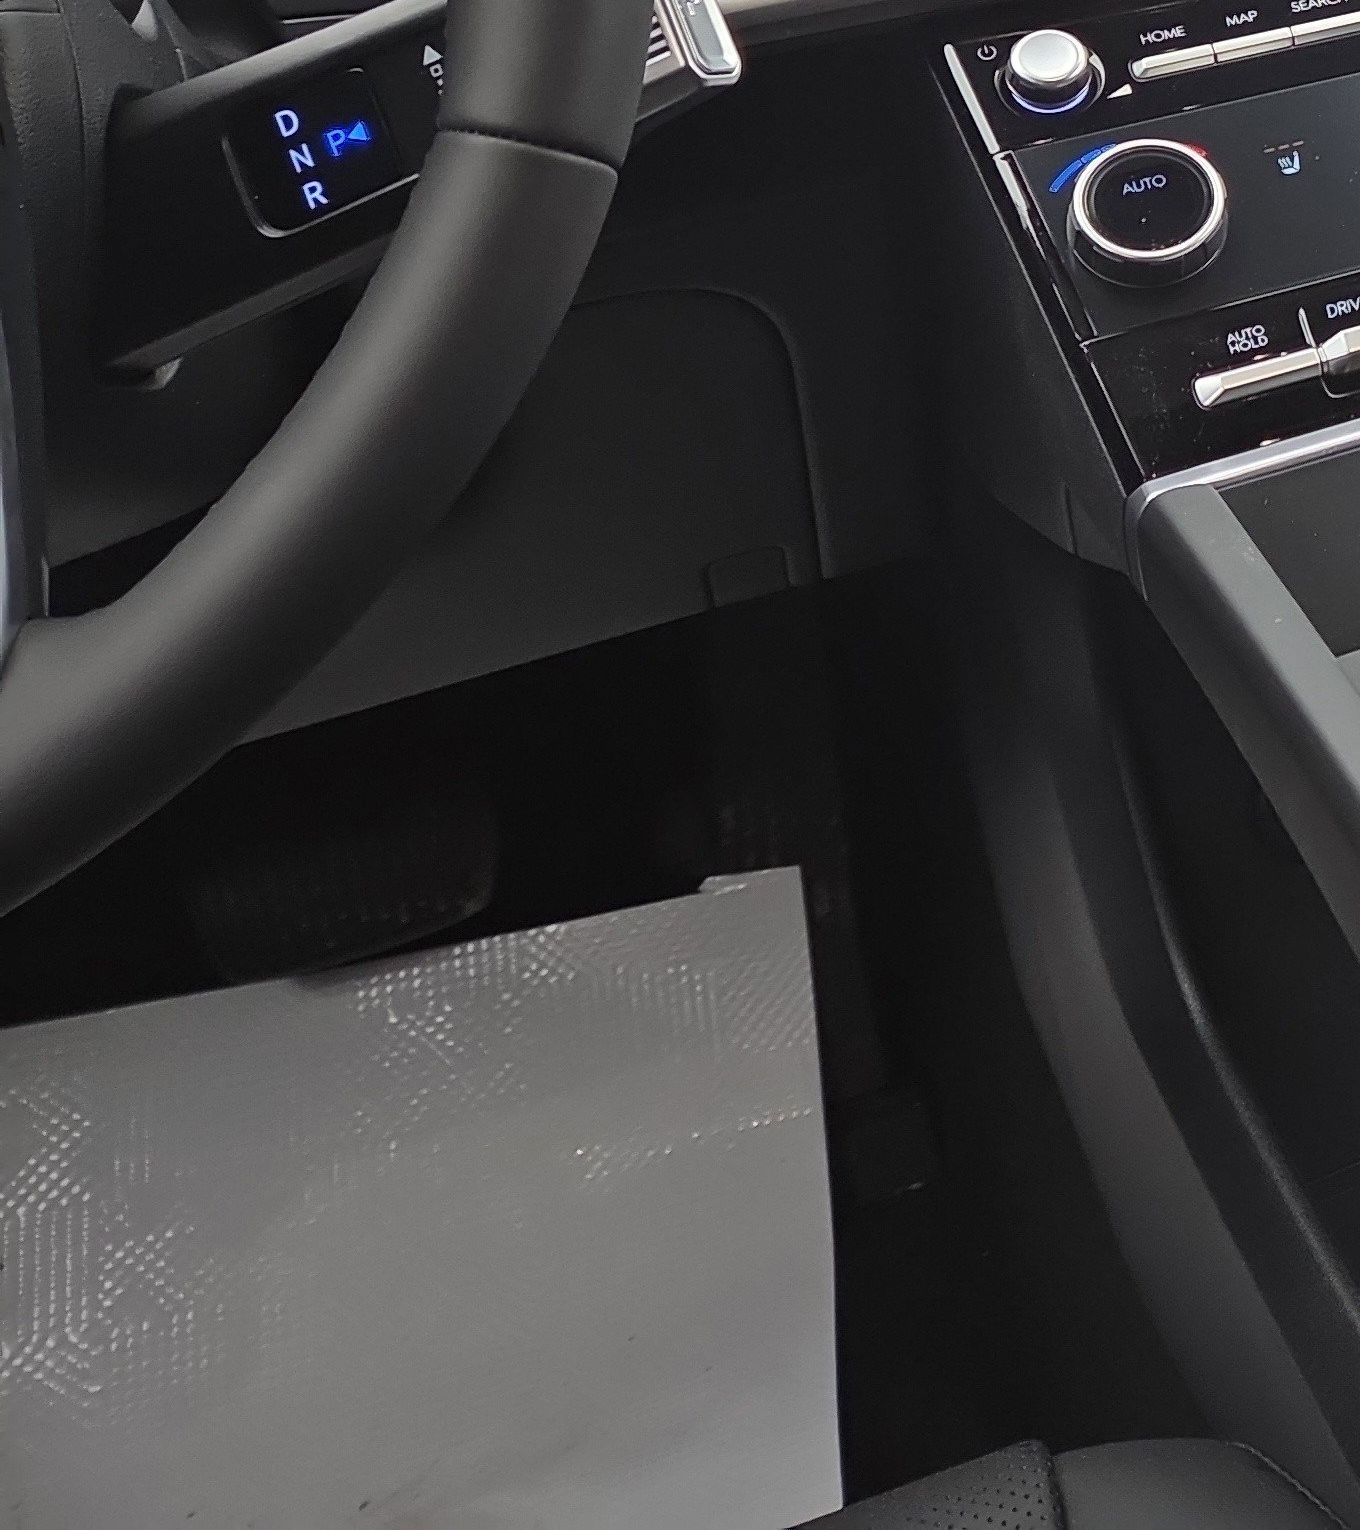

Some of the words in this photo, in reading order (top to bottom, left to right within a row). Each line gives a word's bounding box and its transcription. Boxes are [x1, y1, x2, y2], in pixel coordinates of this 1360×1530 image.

[1225, 10, 1258, 27] MAP
[1140, 25, 1187, 45] HOME
[274, 109, 299, 138] D
[326, 129, 346, 157] P
[289, 143, 315, 174] N
[303, 181, 329, 210] R
[1122, 175, 1167, 196] AUTO
[1226, 324, 1265, 346] AUTO
[1229, 336, 1268, 355] HOLD
